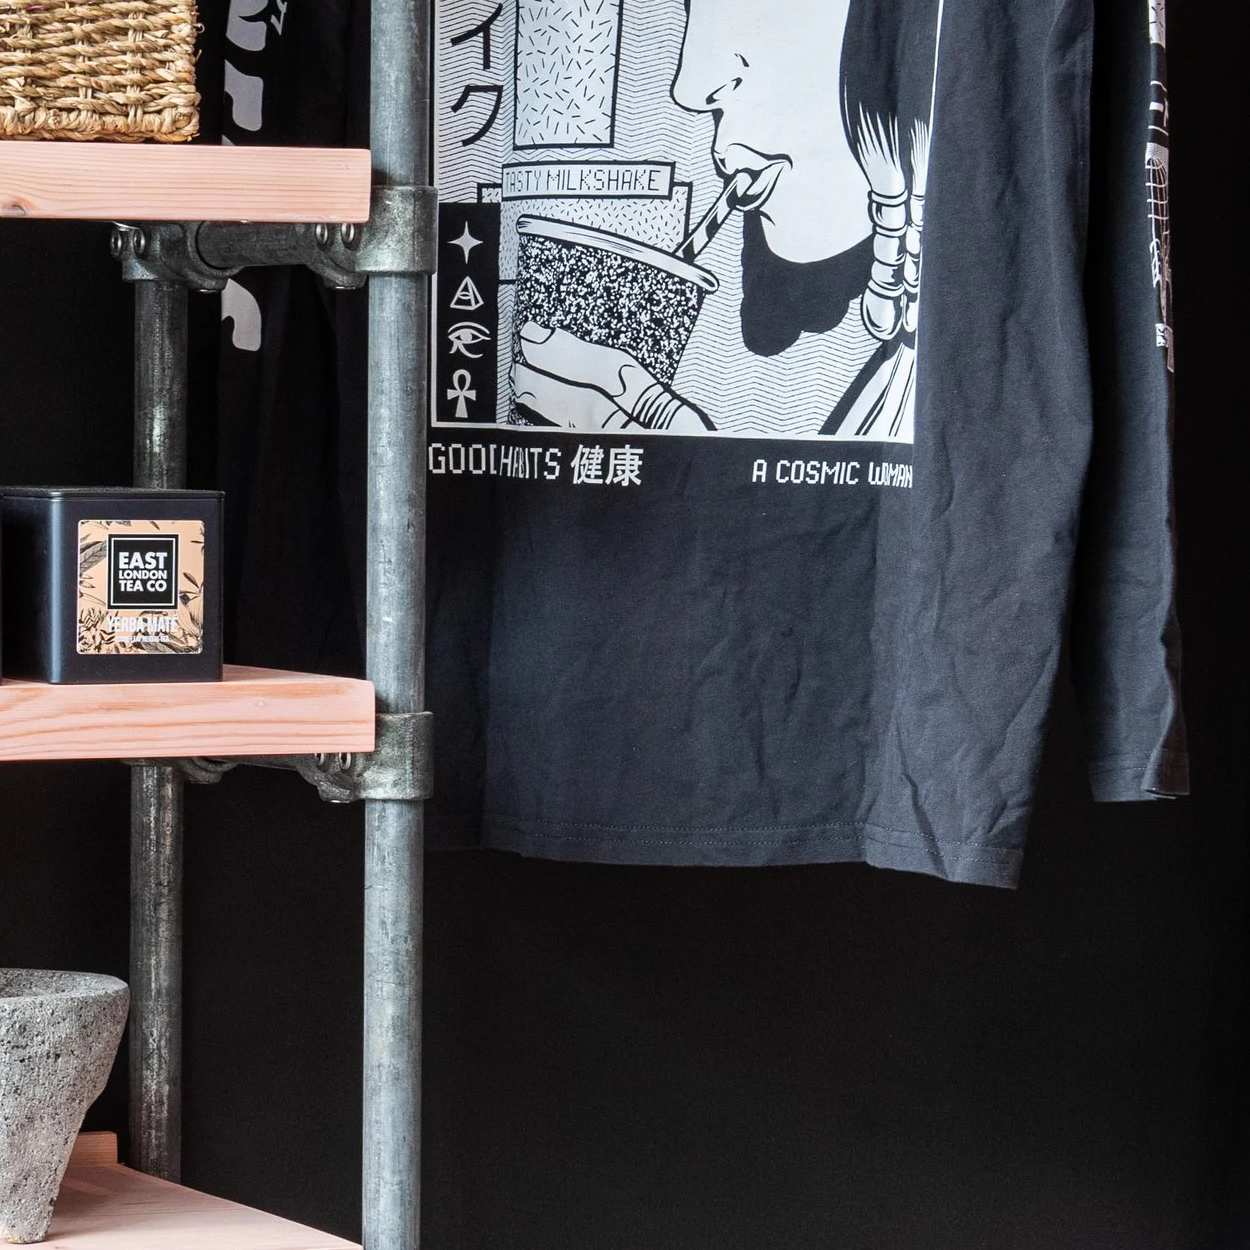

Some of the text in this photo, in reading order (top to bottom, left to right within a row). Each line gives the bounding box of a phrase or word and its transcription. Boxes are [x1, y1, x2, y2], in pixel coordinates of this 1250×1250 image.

[505, 169, 661, 193] TASTY MILKSHAKE
[570, 444, 645, 487] 健康
[752, 459, 768, 483] A
[775, 459, 860, 485] COSMIC
[119, 552, 167, 569] EAST
[119, 570, 167, 579] LONDON
[119, 580, 167, 592] TEA CO
[107, 616, 145, 632] YERBA
